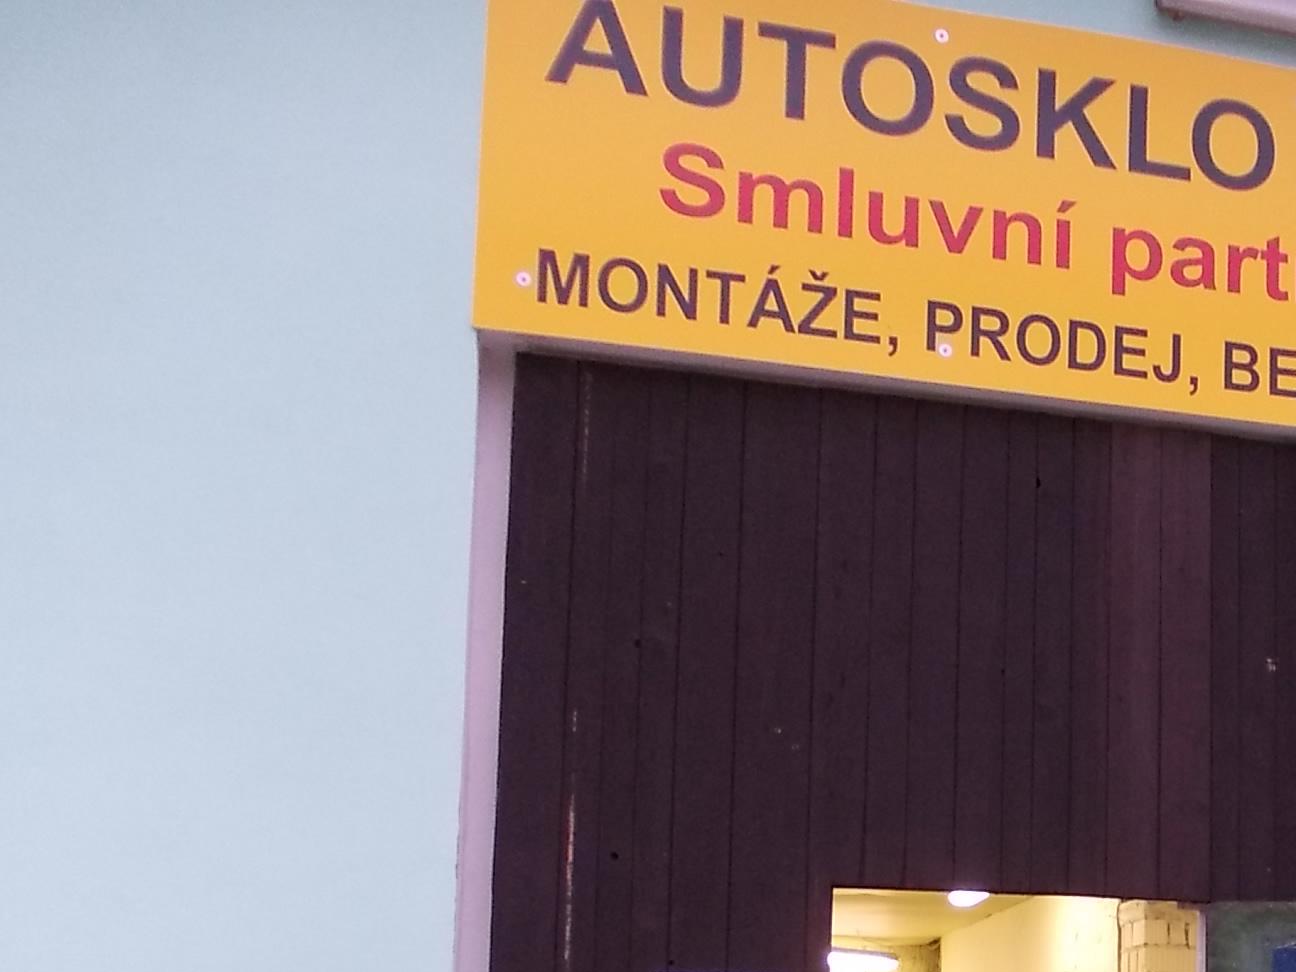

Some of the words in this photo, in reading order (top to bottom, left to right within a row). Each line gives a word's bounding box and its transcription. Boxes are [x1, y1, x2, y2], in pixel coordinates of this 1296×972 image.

[545, 0, 1275, 190] AUTOSKLO
[659, 142, 1078, 270] Smluvní
[535, 248, 899, 358] MONTÁŽE,
[926, 300, 1199, 395] PRODEJ,
